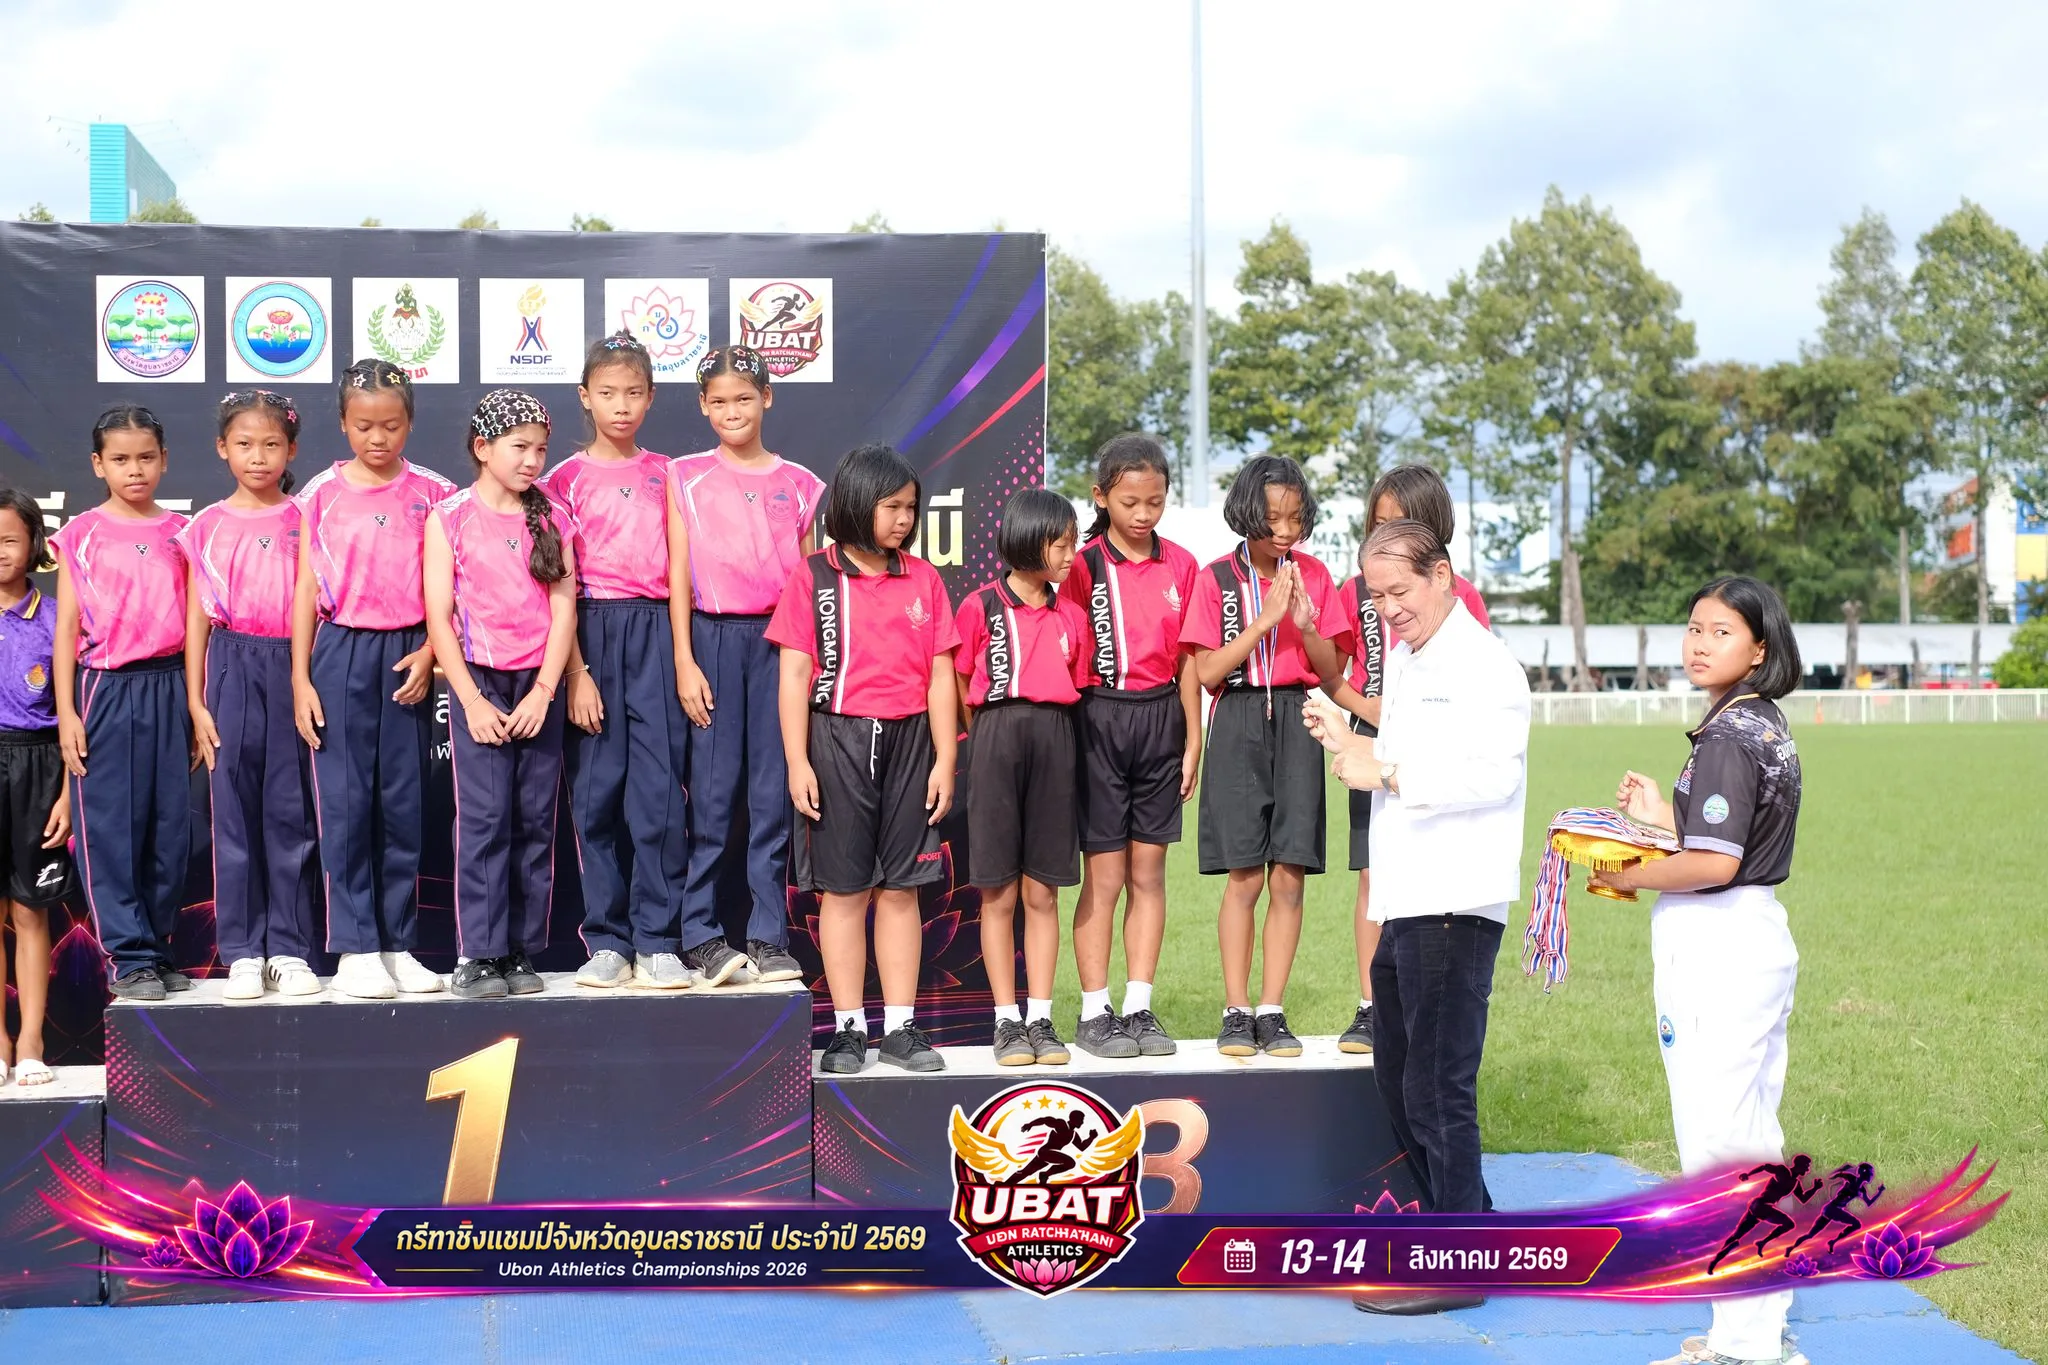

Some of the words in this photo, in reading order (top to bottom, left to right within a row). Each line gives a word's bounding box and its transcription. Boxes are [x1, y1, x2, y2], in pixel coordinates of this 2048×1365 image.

[510, 355, 552, 364] NSDF
[746, 331, 817, 349] UBAT
[815, 588, 838, 703] NONGMUANG
[917, 851, 942, 863] SPORT
[425, 1038, 520, 1206] 1
[1122, 1098, 1209, 1214] 3
